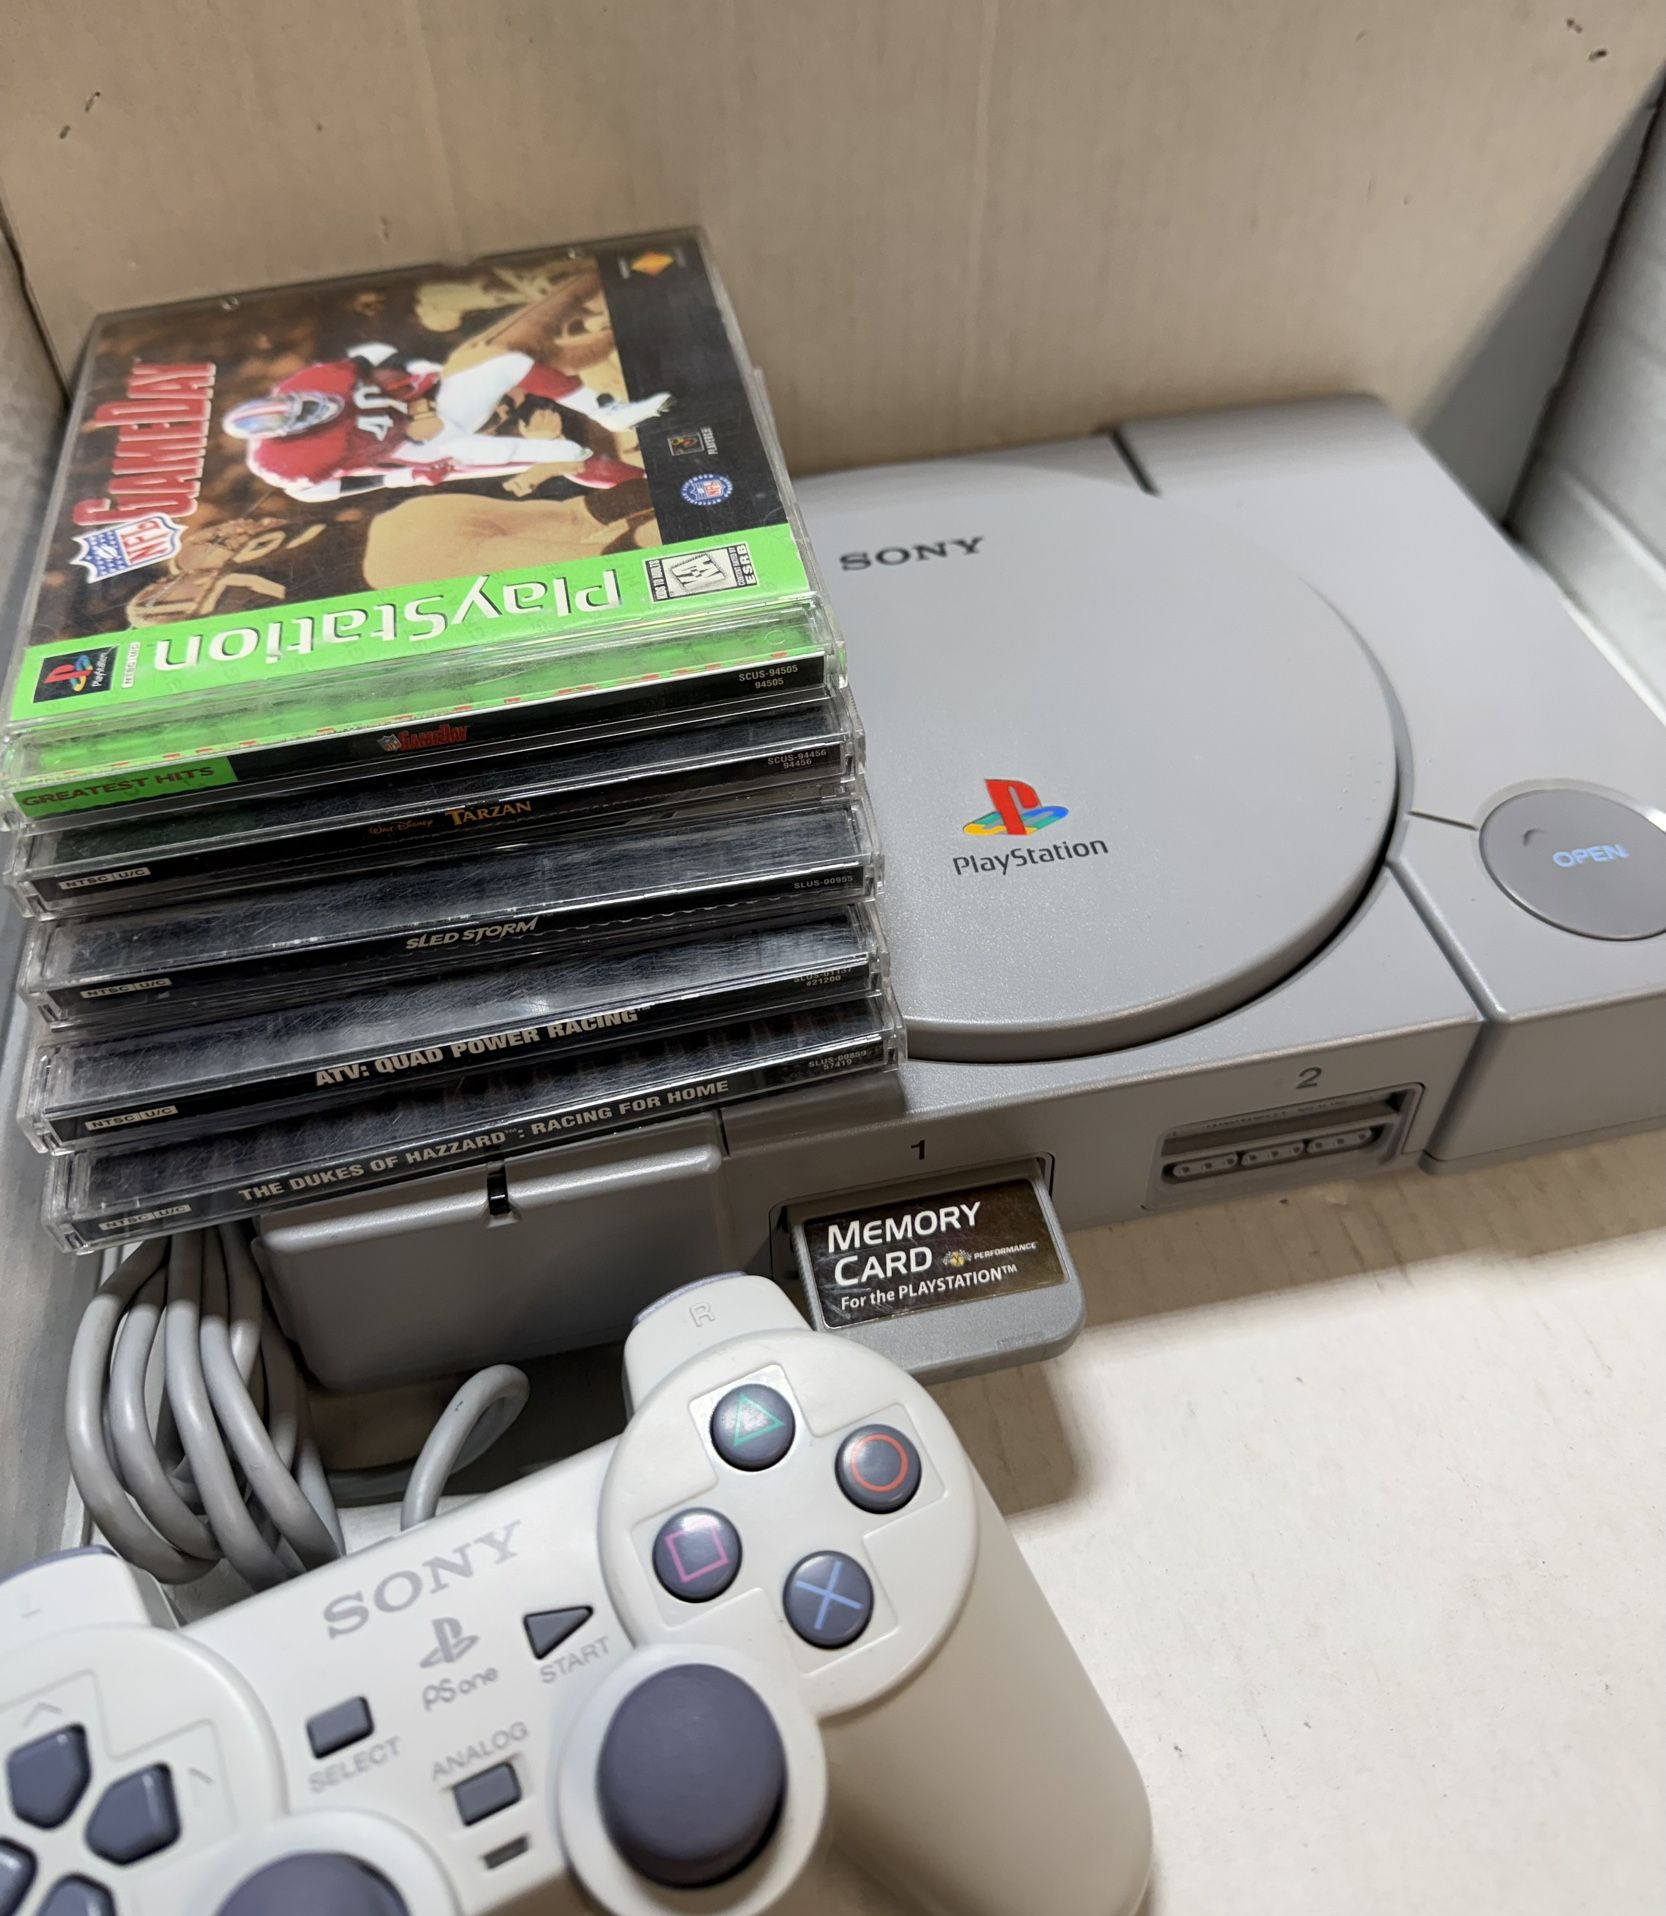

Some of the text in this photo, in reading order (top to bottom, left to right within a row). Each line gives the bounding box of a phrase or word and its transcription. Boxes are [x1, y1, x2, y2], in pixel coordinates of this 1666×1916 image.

[120, 520, 167, 565] NFL
[839, 536, 985, 572] SONY
[737, 544, 758, 584] ESRB
[154, 567, 622, 673] PlayStation
[739, 664, 799, 682] SCUS-94505
[755, 677, 784, 689] 94505
[768, 748, 827, 765] SCUS-94456
[783, 758, 812, 769] 94456
[21, 765, 216, 806] GREATEST HITS
[445, 801, 532, 826] TARZAN
[952, 838, 1110, 876] PlayStation
[1552, 844, 1630, 868] OPEN
[66, 868, 147, 888] NTSC U/C
[794, 874, 854, 890] SLUS-00955
[405, 915, 539, 950] SLED STORM
[88, 979, 167, 998] NTSC U/C
[806, 975, 842, 987] #21200
[316, 1062, 370, 1087] ATV:
[374, 1048, 444, 1074] QUAD
[452, 1028, 541, 1058] POWER
[1296, 1067, 1323, 1090] 2
[91, 1107, 173, 1130] NTSC U/C
[238, 1181, 285, 1201] THE
[289, 1164, 365, 1191] DUKES
[370, 1155, 399, 1173] OF
[531, 1108, 614, 1136] RACING
[619, 1096, 662, 1116] FOR
[667, 1080, 729, 1105] HOME
[910, 1139, 927, 1161] 1
[105, 1206, 188, 1230] NTSC U/C
[827, 1201, 982, 1254] MEMORY
[974, 1242, 1037, 1260] PERFORMANCE
[834, 1245, 934, 1287] CARD
[841, 1294, 867, 1311] For
[870, 1287, 896, 1305] the
[688, 1302, 717, 1328] R
[323, 1519, 522, 1640] SONY
[541, 1636, 612, 1684] START
[431, 1721, 530, 1782] ANALOG
[308, 1736, 401, 1794] SELECT
